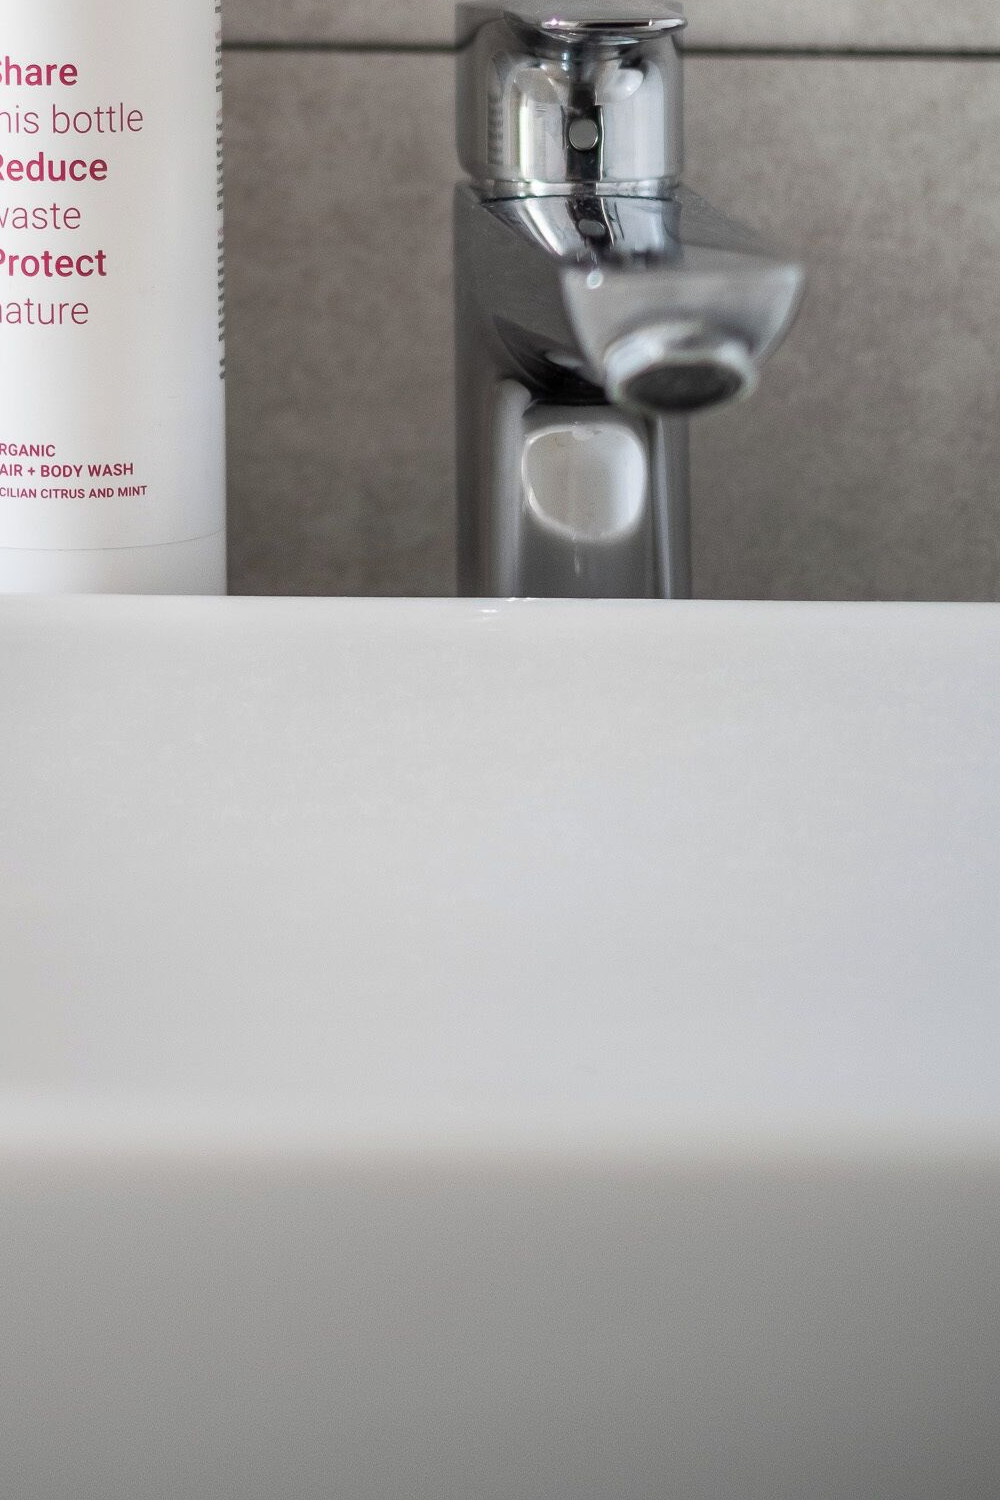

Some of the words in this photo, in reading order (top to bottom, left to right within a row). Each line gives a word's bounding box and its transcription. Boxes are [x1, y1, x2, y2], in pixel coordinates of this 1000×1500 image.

[52, 102, 144, 134] bottle
[27, 467, 36, 476] +
[40, 464, 83, 478] BODY
[87, 462, 134, 477] WASH
[40, 487, 86, 499] CITRUS
[88, 487, 114, 499] AND
[117, 485, 148, 497] MINT
